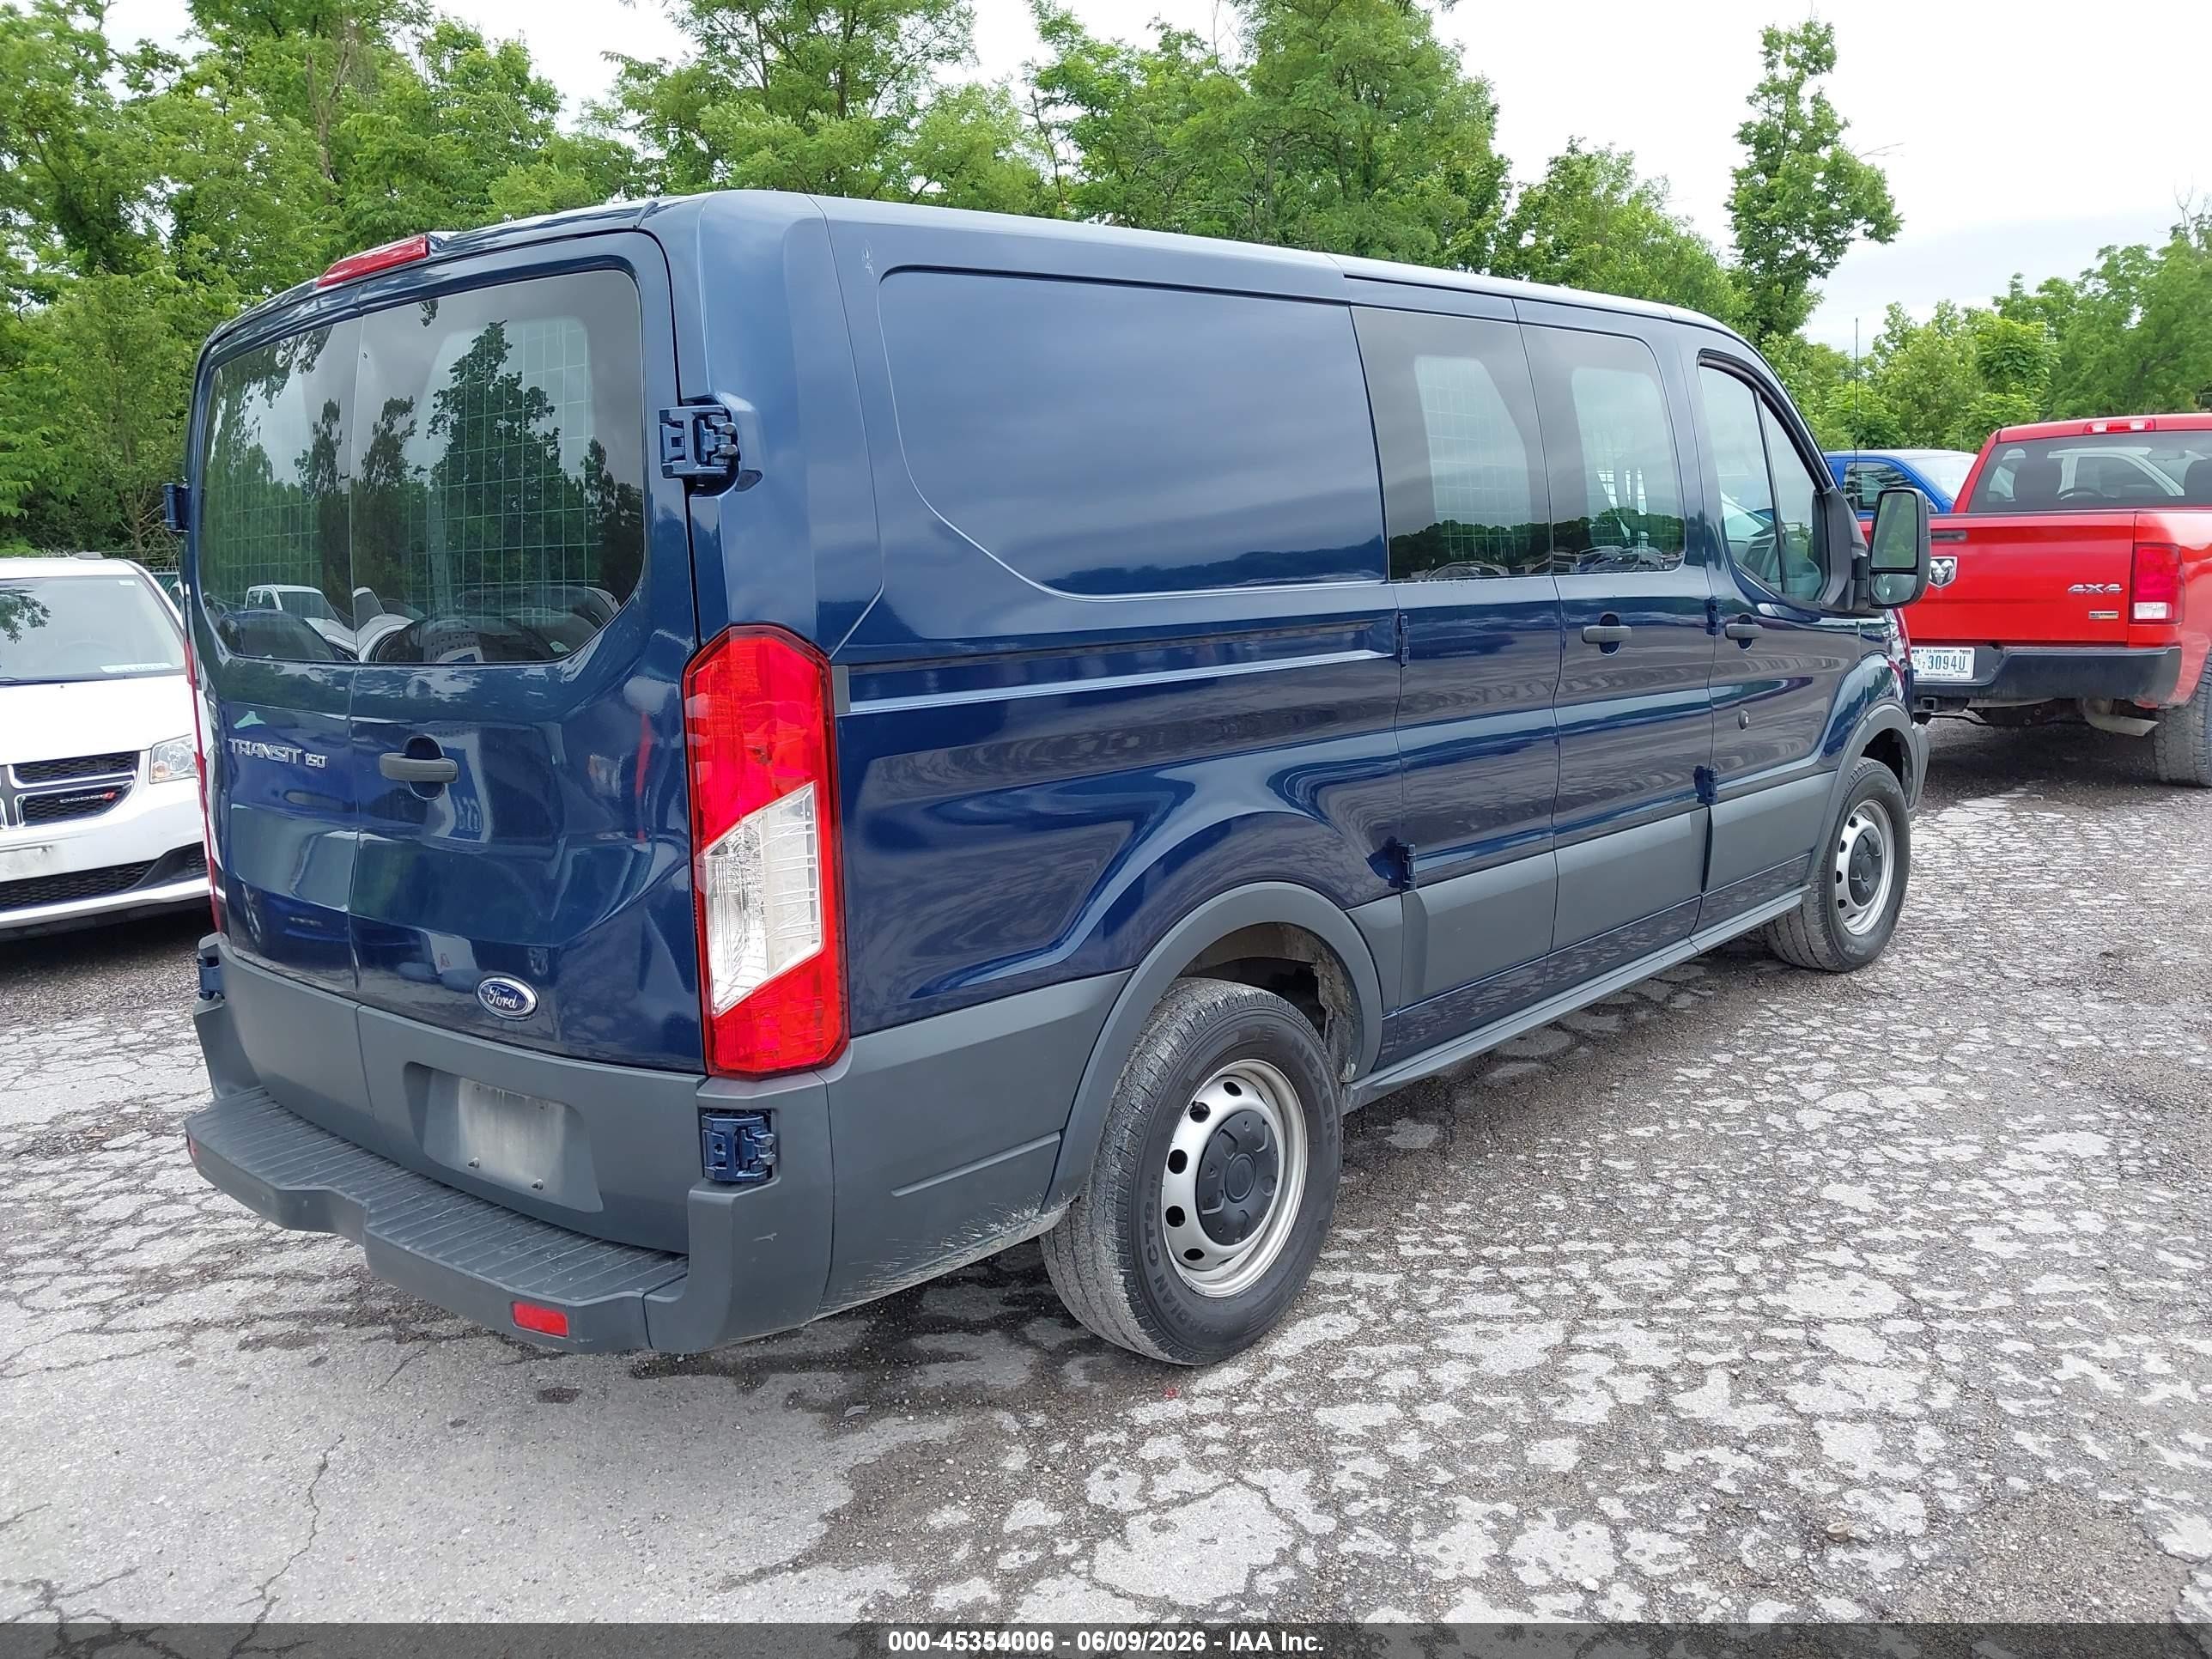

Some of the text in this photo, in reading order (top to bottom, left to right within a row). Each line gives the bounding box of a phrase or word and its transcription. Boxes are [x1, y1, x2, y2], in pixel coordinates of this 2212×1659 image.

[1927, 655, 1966, 670] 3094U
[228, 738, 327, 769] TRANSIT 150
[487, 985, 518, 1009] Ford
